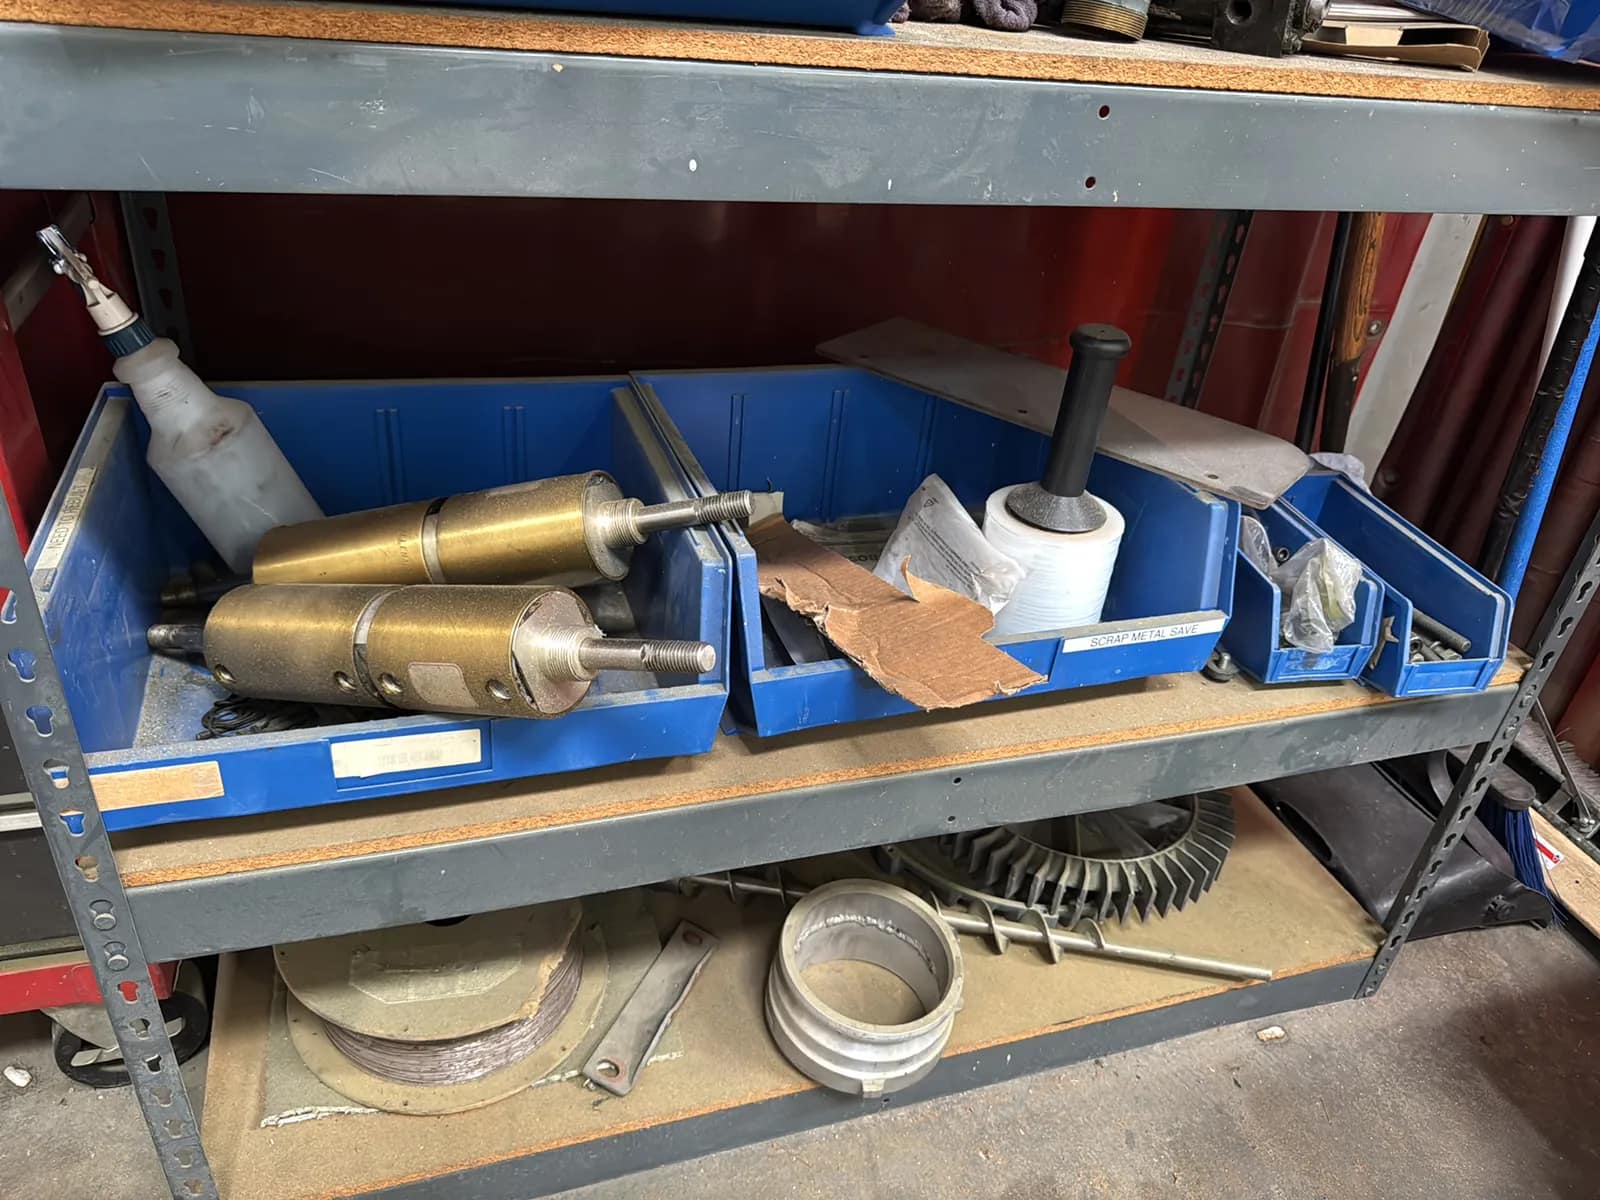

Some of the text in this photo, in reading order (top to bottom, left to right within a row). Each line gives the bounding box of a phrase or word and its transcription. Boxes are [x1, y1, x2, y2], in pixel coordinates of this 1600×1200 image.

[47, 526, 69, 549] NEED
[1090, 624, 1200, 648] SCRAP METAL SAVE
